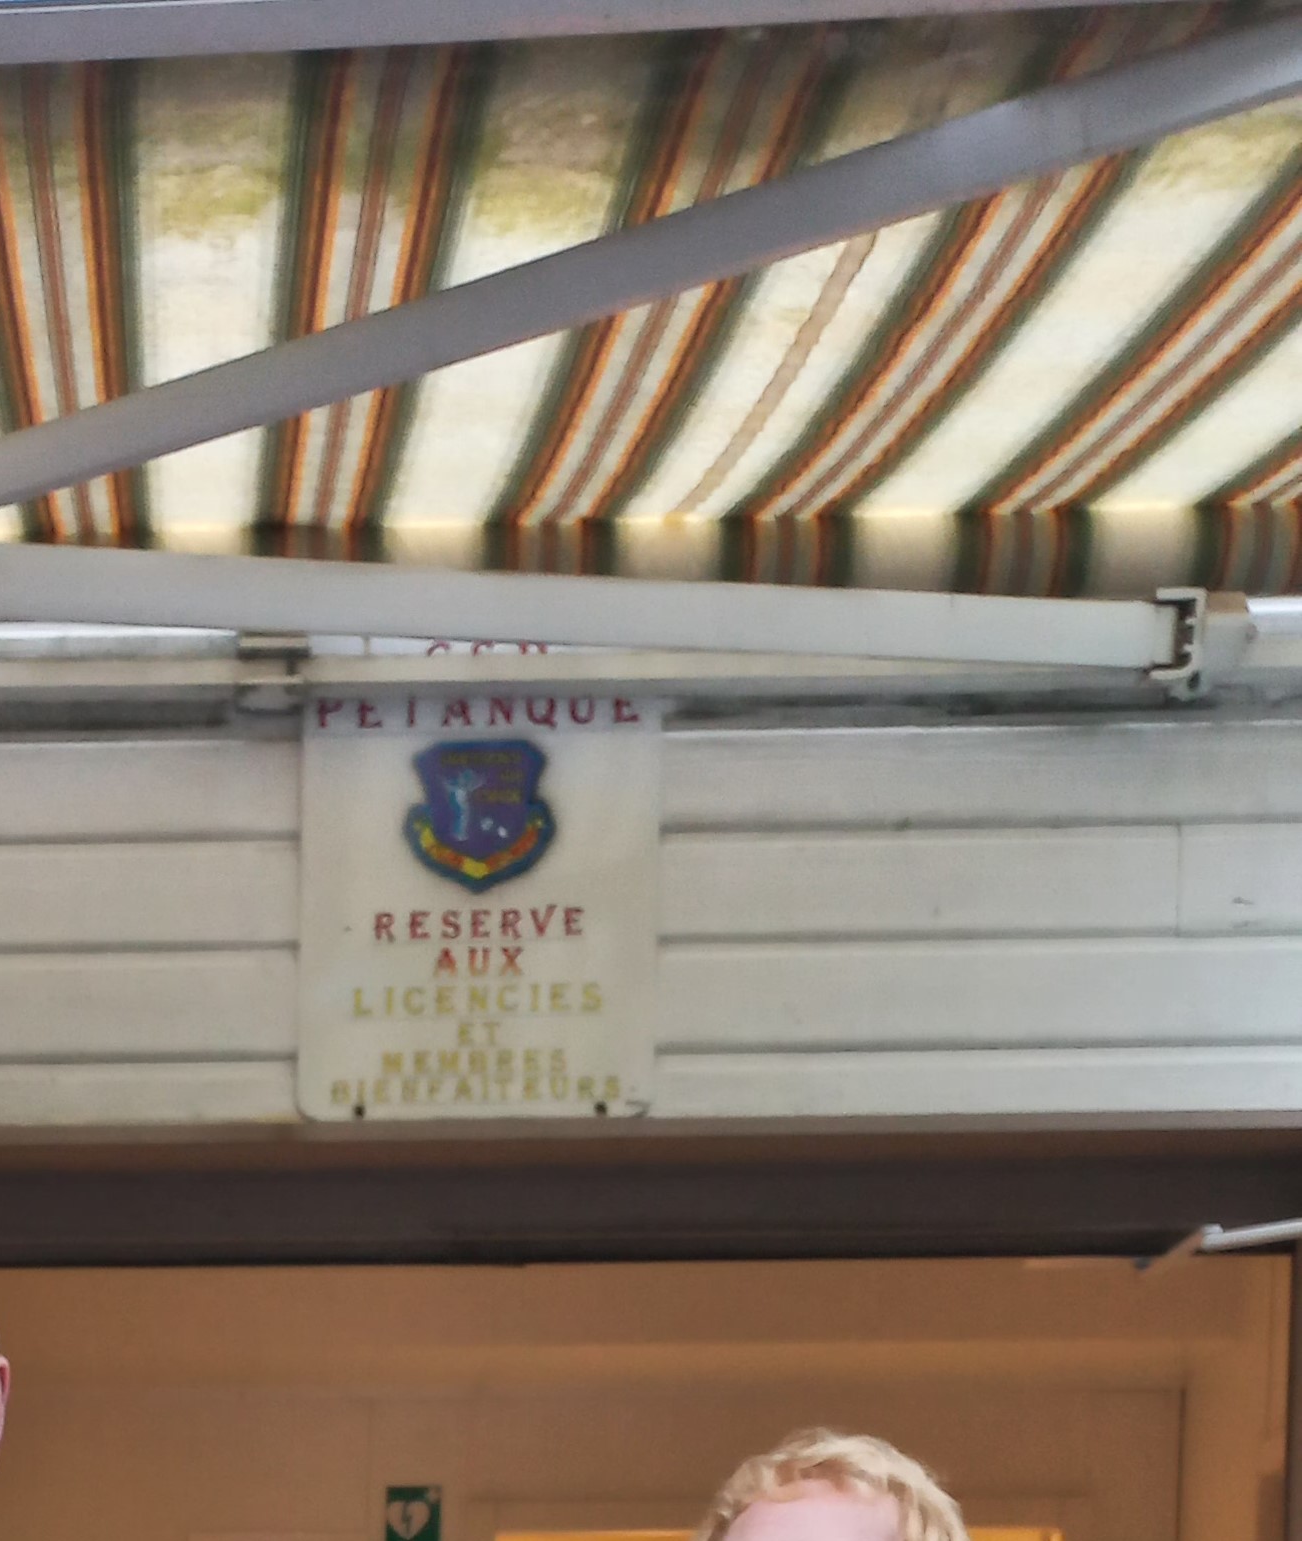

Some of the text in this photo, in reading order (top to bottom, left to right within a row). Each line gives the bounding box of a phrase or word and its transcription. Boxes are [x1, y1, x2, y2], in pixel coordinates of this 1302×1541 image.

[373, 904, 586, 942] RESERVE
[433, 946, 525, 978] AUX
[352, 982, 603, 1017] LICENCIES
[458, 1021, 501, 1046] ET
[381, 1048, 567, 1075] MEMBRES
